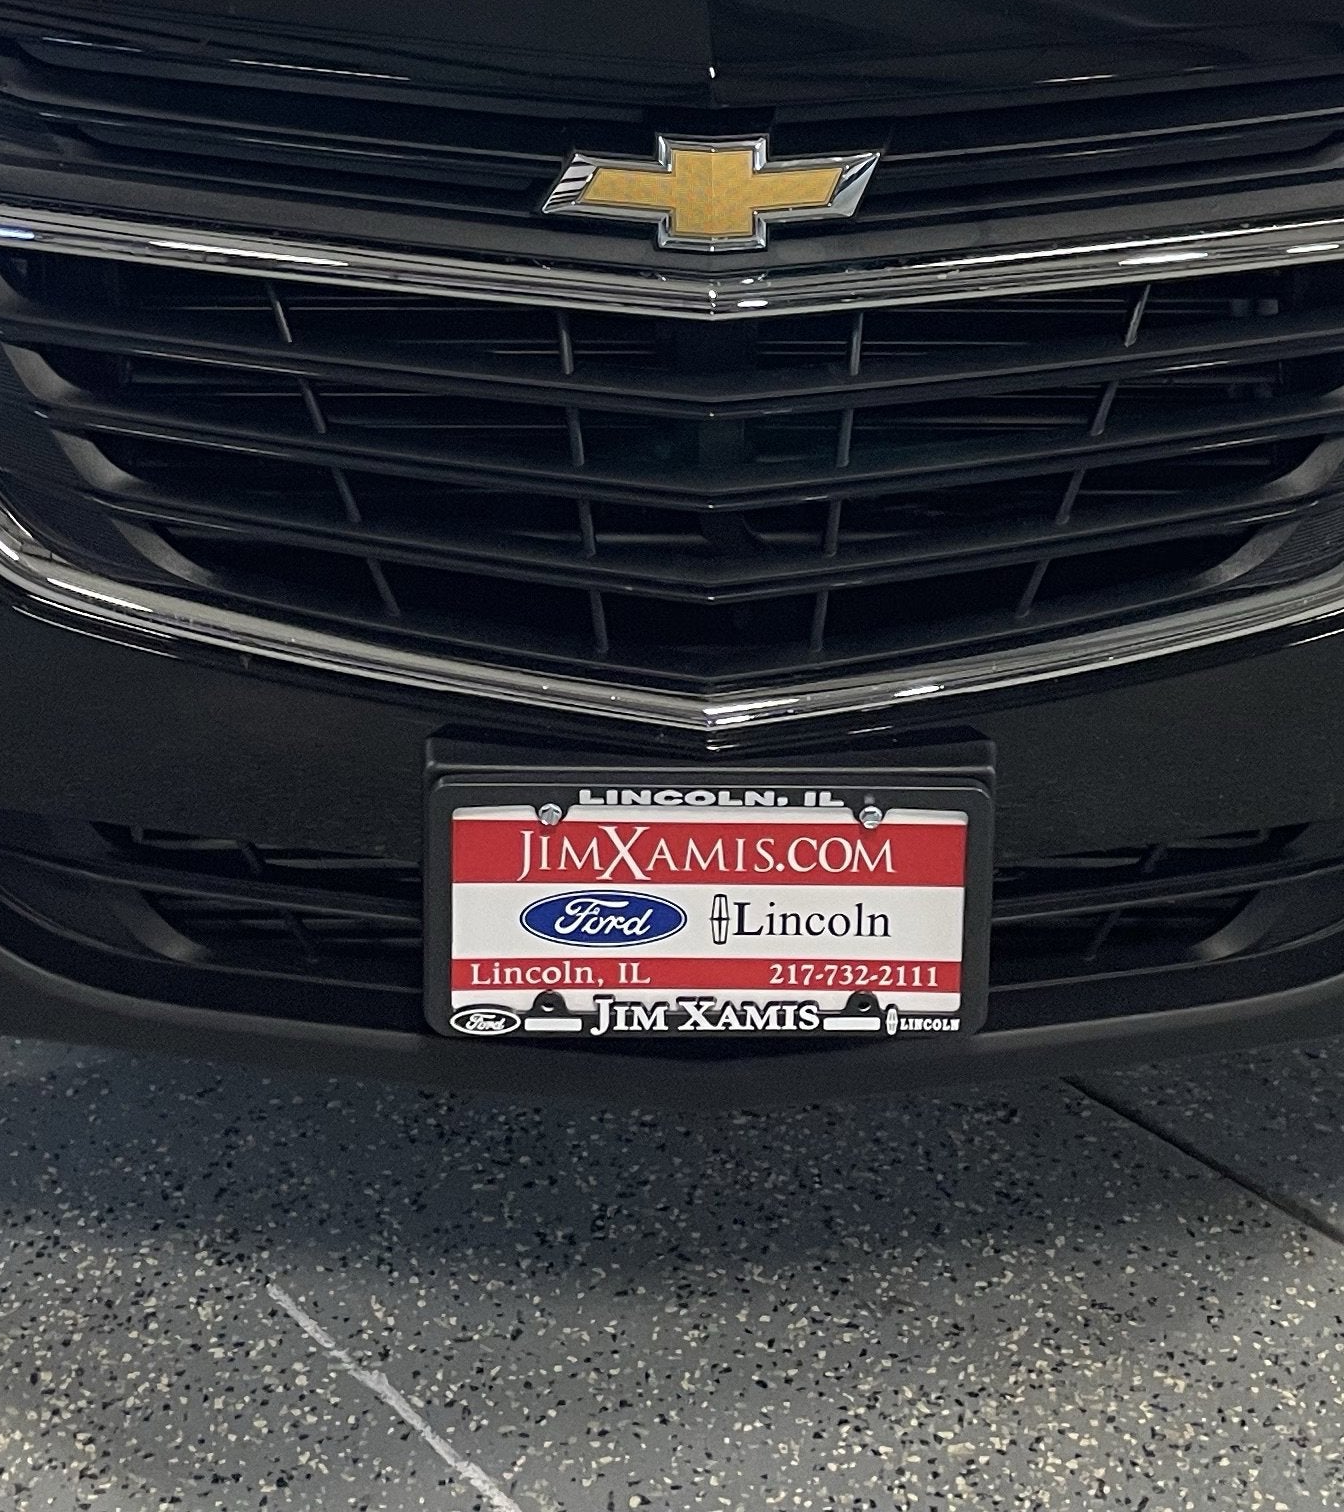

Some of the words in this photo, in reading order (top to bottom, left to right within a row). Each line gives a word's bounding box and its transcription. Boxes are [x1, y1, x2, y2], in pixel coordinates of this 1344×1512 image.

[579, 789, 787, 808] LINCOLN,
[804, 792, 846, 807] IL
[554, 897, 654, 937] Ford
[732, 901, 891, 938] Lincoln
[471, 960, 605, 988] Lincoln,
[618, 962, 652, 984] IL
[769, 964, 939, 987] 217-732-2111
[899, 1018, 960, 1031] LINCOLN
